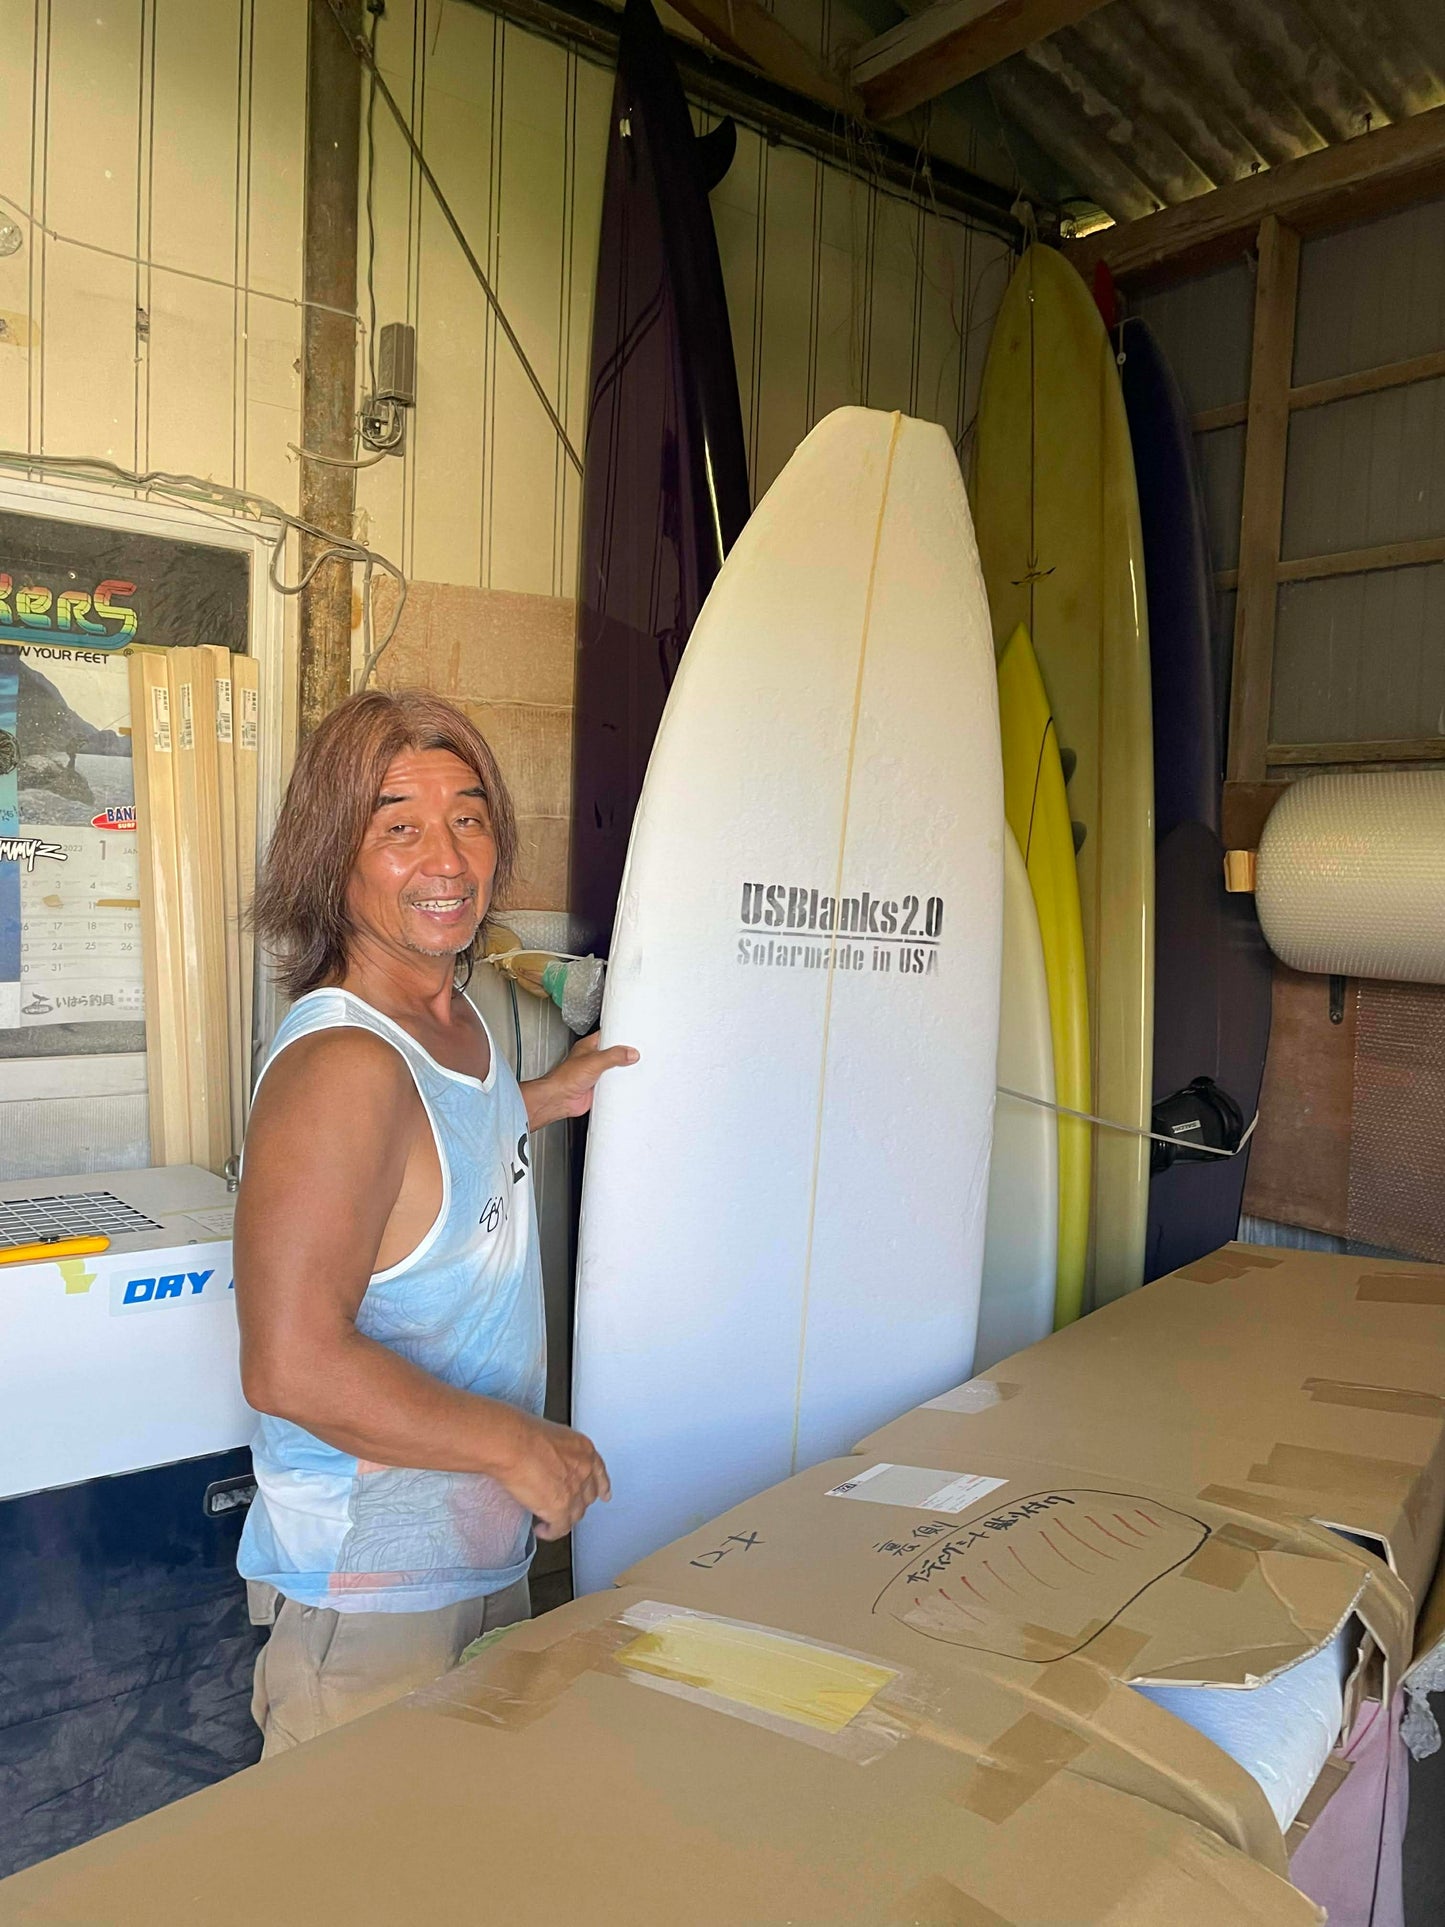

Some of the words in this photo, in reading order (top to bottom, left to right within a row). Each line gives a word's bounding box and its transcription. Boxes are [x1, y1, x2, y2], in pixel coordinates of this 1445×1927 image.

[33, 647, 71, 661] YOUR
[75, 651, 109, 664] FEET
[99, 840, 107, 860] 1
[55, 880, 61, 889] 3
[90, 881, 96, 889] 4
[740, 882, 944, 938] USBlanks2.0
[54, 922, 63, 930] 17
[88, 922, 97, 930] 18
[124, 923, 133, 932] 19
[52, 943, 63, 951] 24
[85, 942, 96, 950] 25
[121, 943, 133, 951] 26
[737, 938, 864, 971] Solarmade
[872, 946, 891, 972] in
[899, 948, 939, 976] USA
[52, 964, 61, 972] 31
